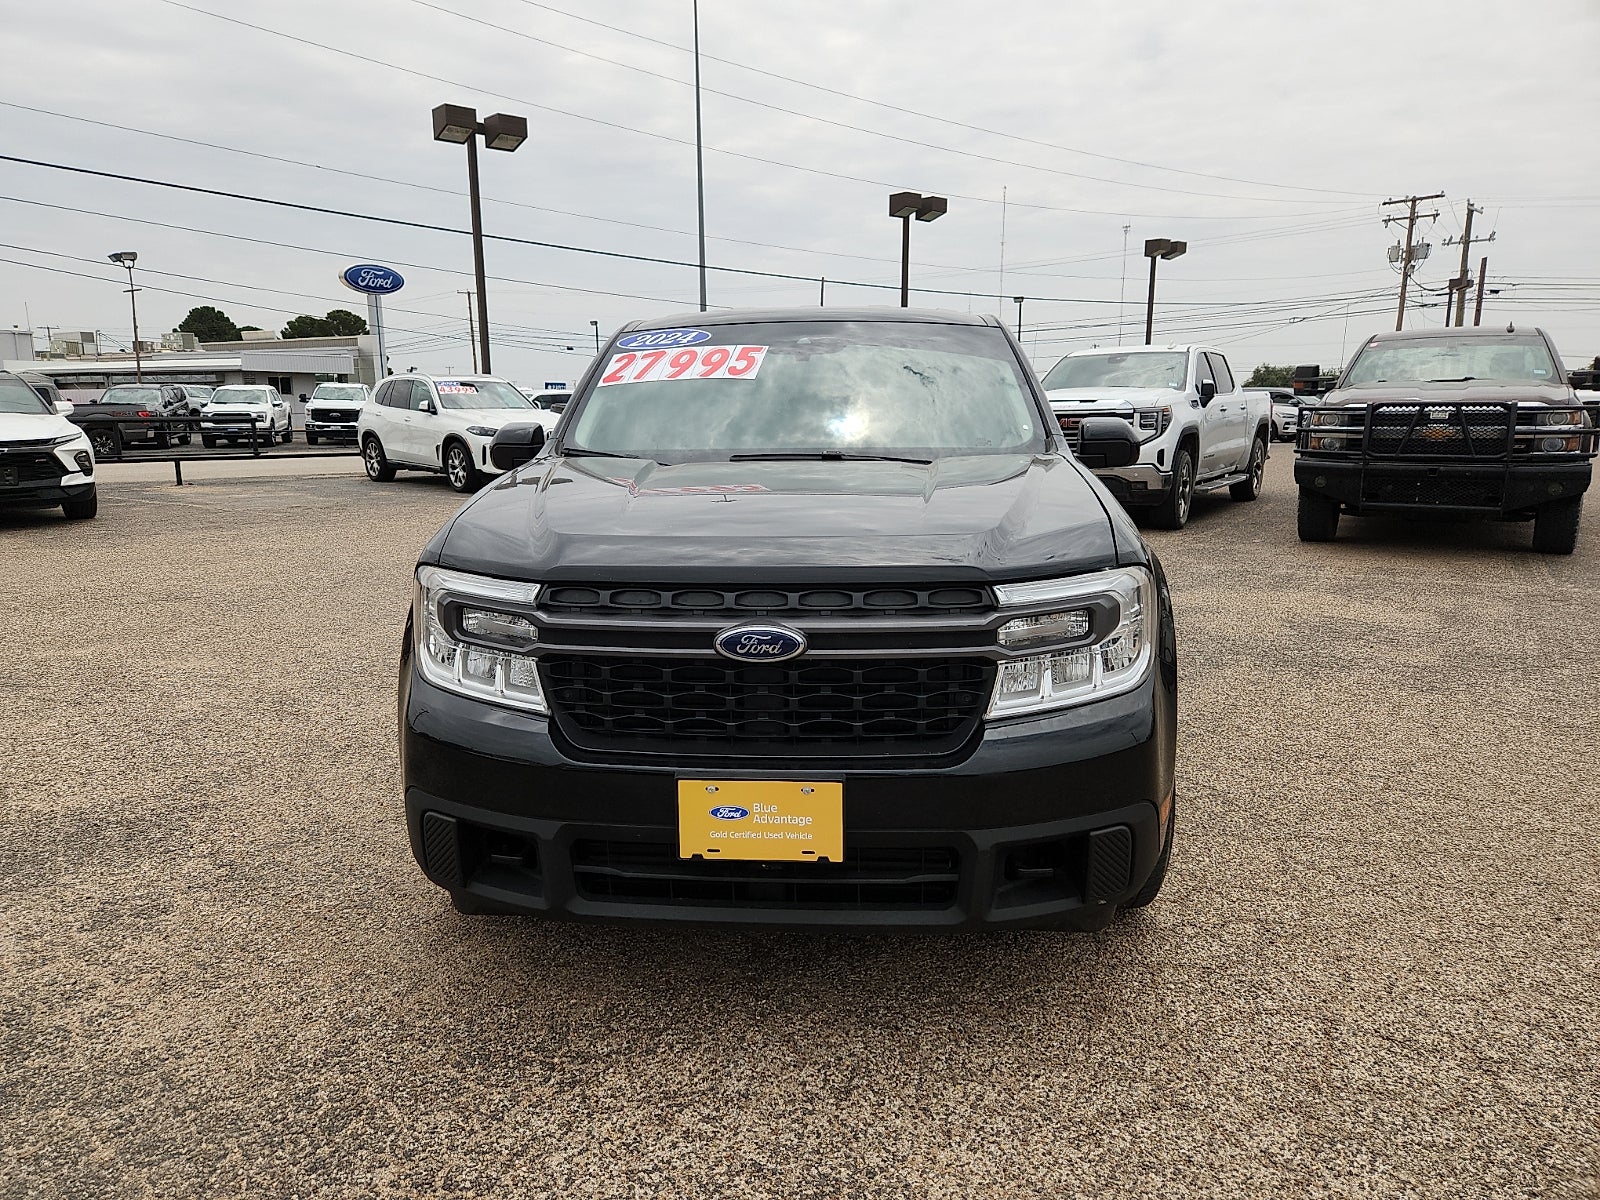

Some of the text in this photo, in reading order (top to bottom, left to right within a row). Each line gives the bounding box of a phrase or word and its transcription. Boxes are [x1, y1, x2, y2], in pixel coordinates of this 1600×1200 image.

[358, 268, 393, 289] Ford
[629, 331, 696, 347] 2024
[602, 346, 764, 384] 27995
[736, 634, 784, 654] Ford
[716, 807, 742, 819] Ford
[752, 803, 778, 813] Blue
[752, 814, 813, 827] Advantage
[709, 830, 813, 840] Gold Certified Used Vehicle
